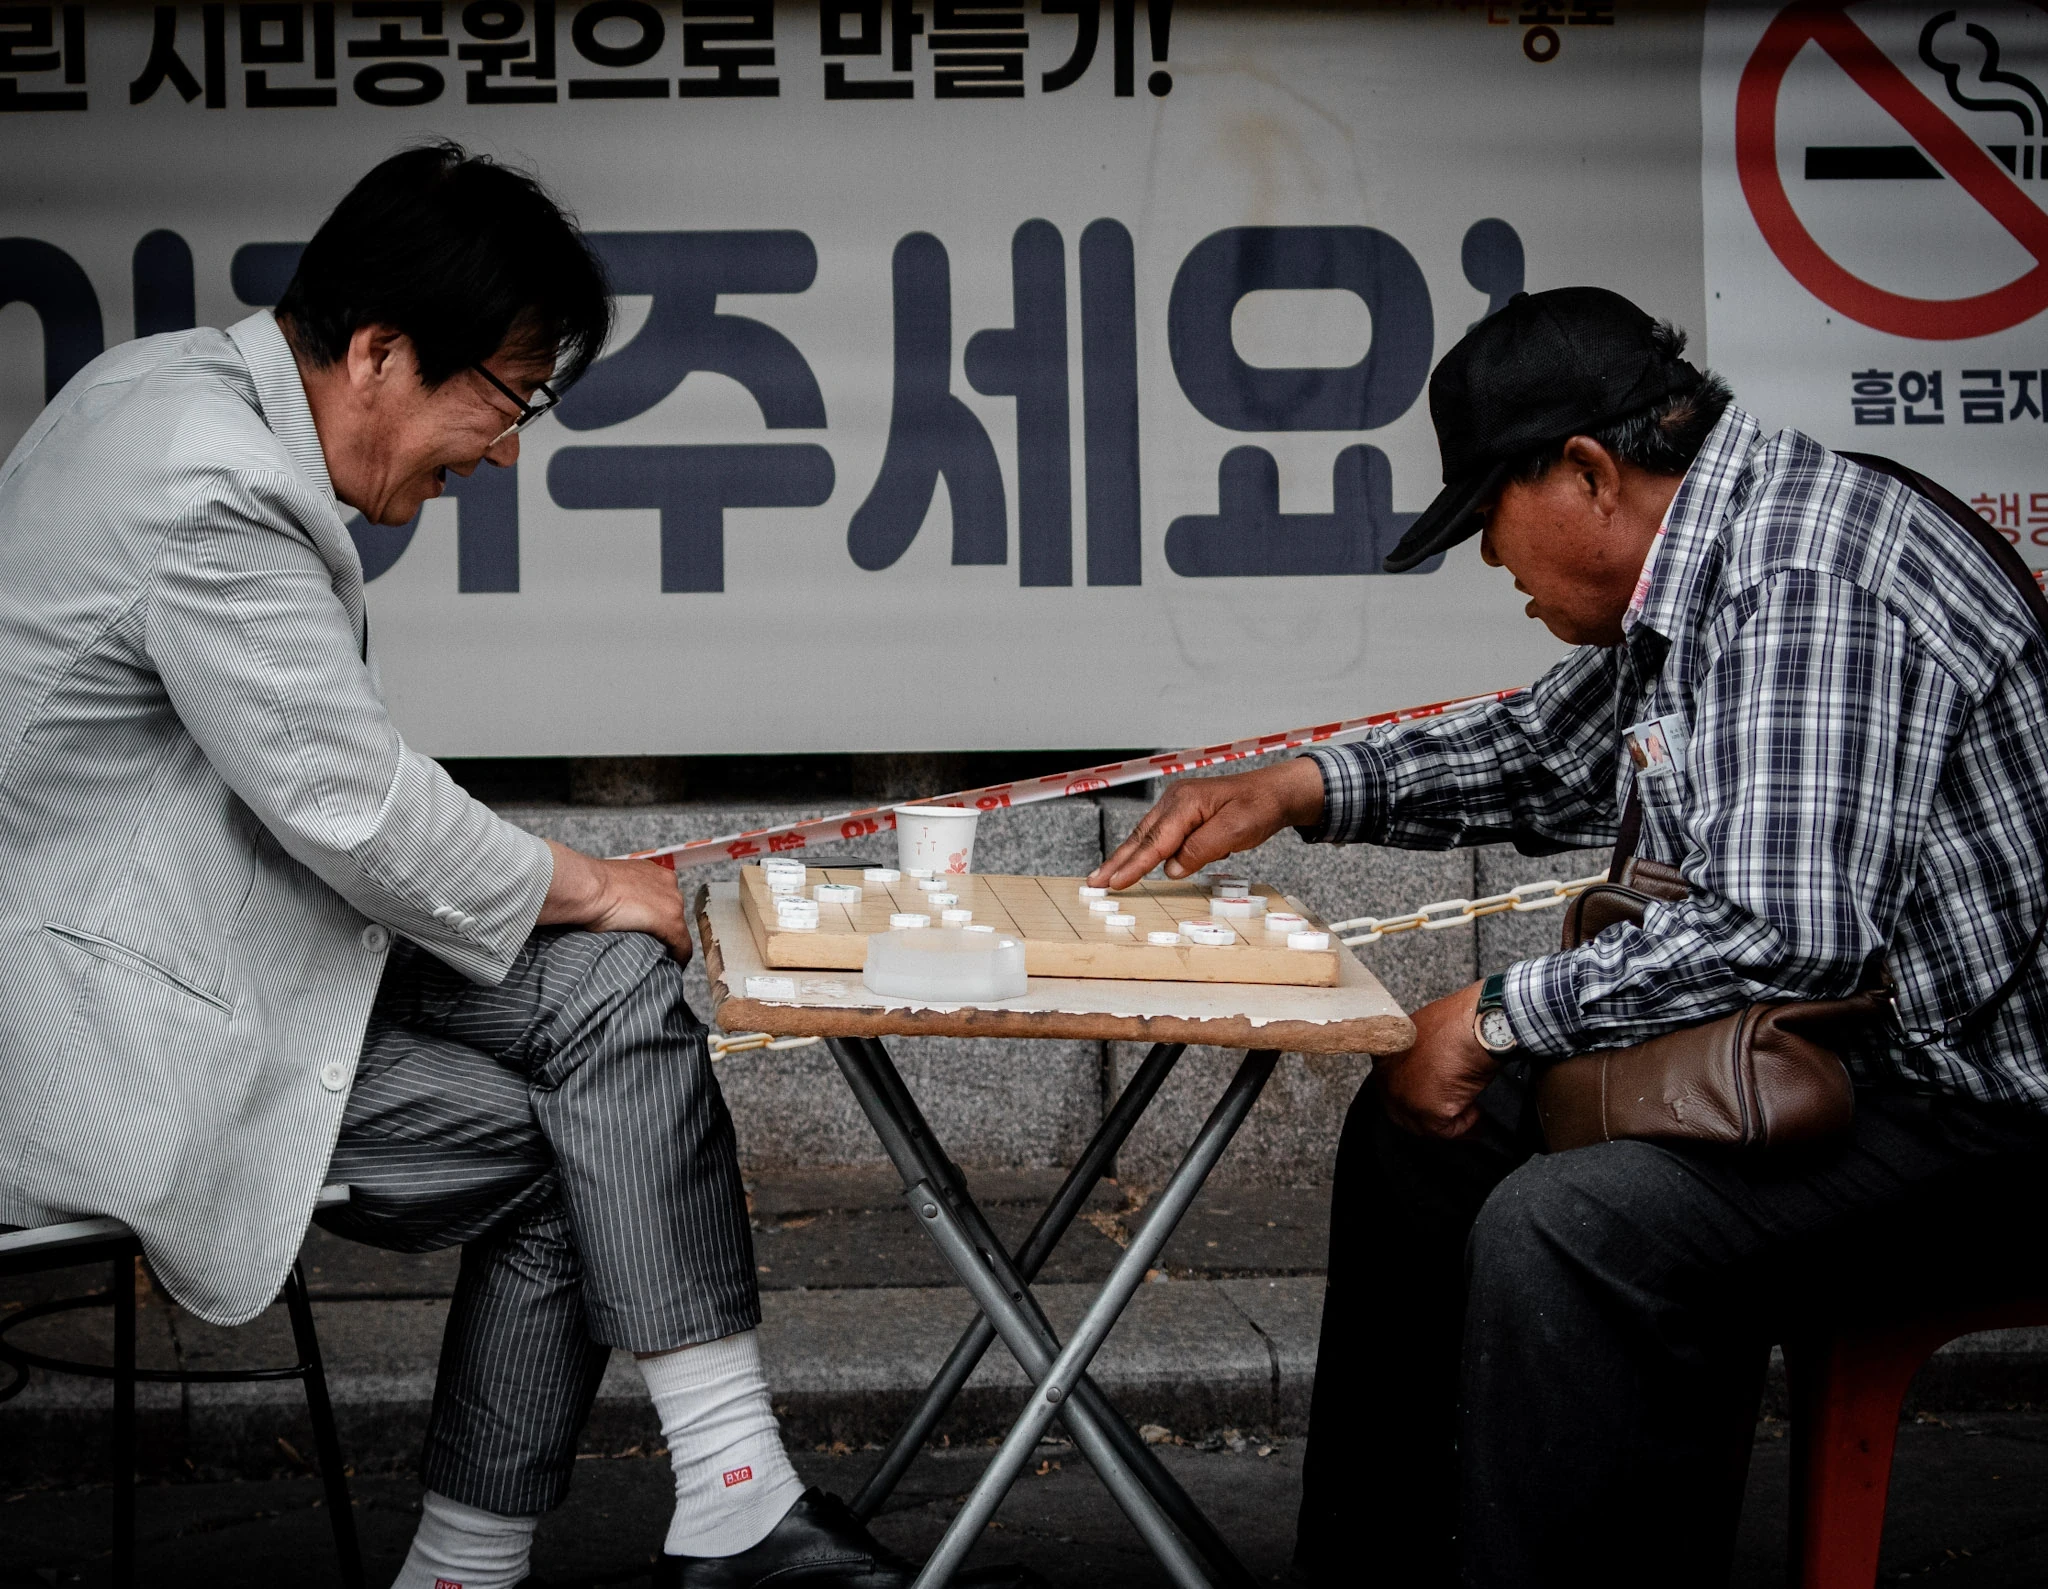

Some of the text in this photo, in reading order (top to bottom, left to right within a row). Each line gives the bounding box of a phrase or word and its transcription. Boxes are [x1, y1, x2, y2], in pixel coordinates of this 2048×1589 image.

[130, 0, 780, 109] 시민공원으로
[820, 0, 1173, 101] 만들기!
[1851, 369, 1944, 425] 흡연
